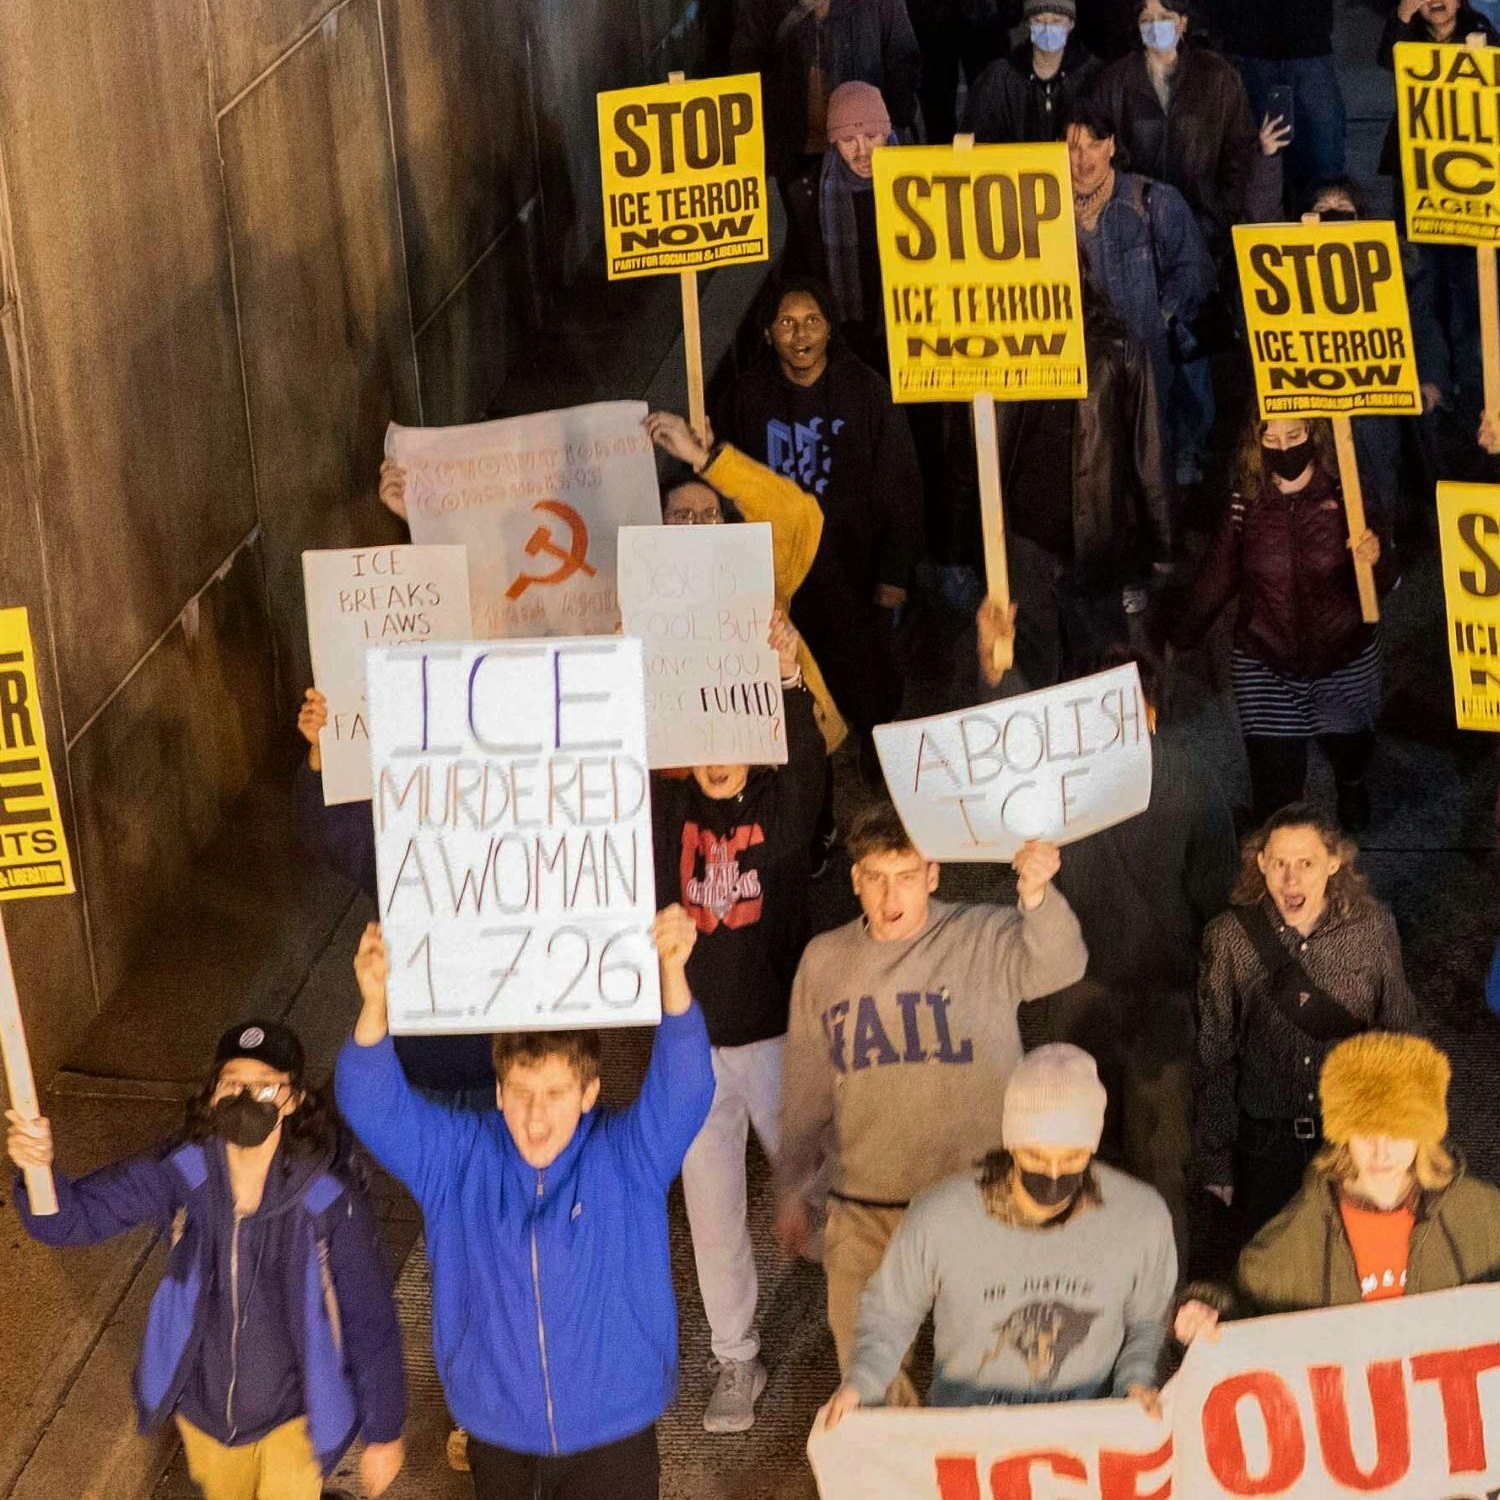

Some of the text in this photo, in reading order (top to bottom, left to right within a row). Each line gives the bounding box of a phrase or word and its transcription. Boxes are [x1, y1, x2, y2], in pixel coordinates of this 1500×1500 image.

[612, 92, 754, 179] STOP
[609, 176, 761, 228] ICE TERROR
[891, 171, 1063, 262] STOP
[620, 214, 755, 254] NOW
[614, 242, 762, 272] PARTY FOR SOCIALISM & LIBERATION
[1249, 240, 1393, 317] STOP
[892, 283, 1073, 324] ICE TERROR
[907, 332, 1067, 358] NOW
[1254, 328, 1407, 364] ICE TERROR
[1269, 363, 1404, 390] NOW
[351, 553, 402, 579] ICE
[338, 582, 442, 612] BREAKS
[363, 613, 432, 638] LAWS
[383, 643, 624, 758] ICE
[700, 681, 779, 717] FUCKED
[914, 684, 1142, 797] ABOLISH
[377, 757, 645, 834] MURDERED
[938, 766, 1093, 850] ICE
[398, 925, 643, 1019] 1.7.26
